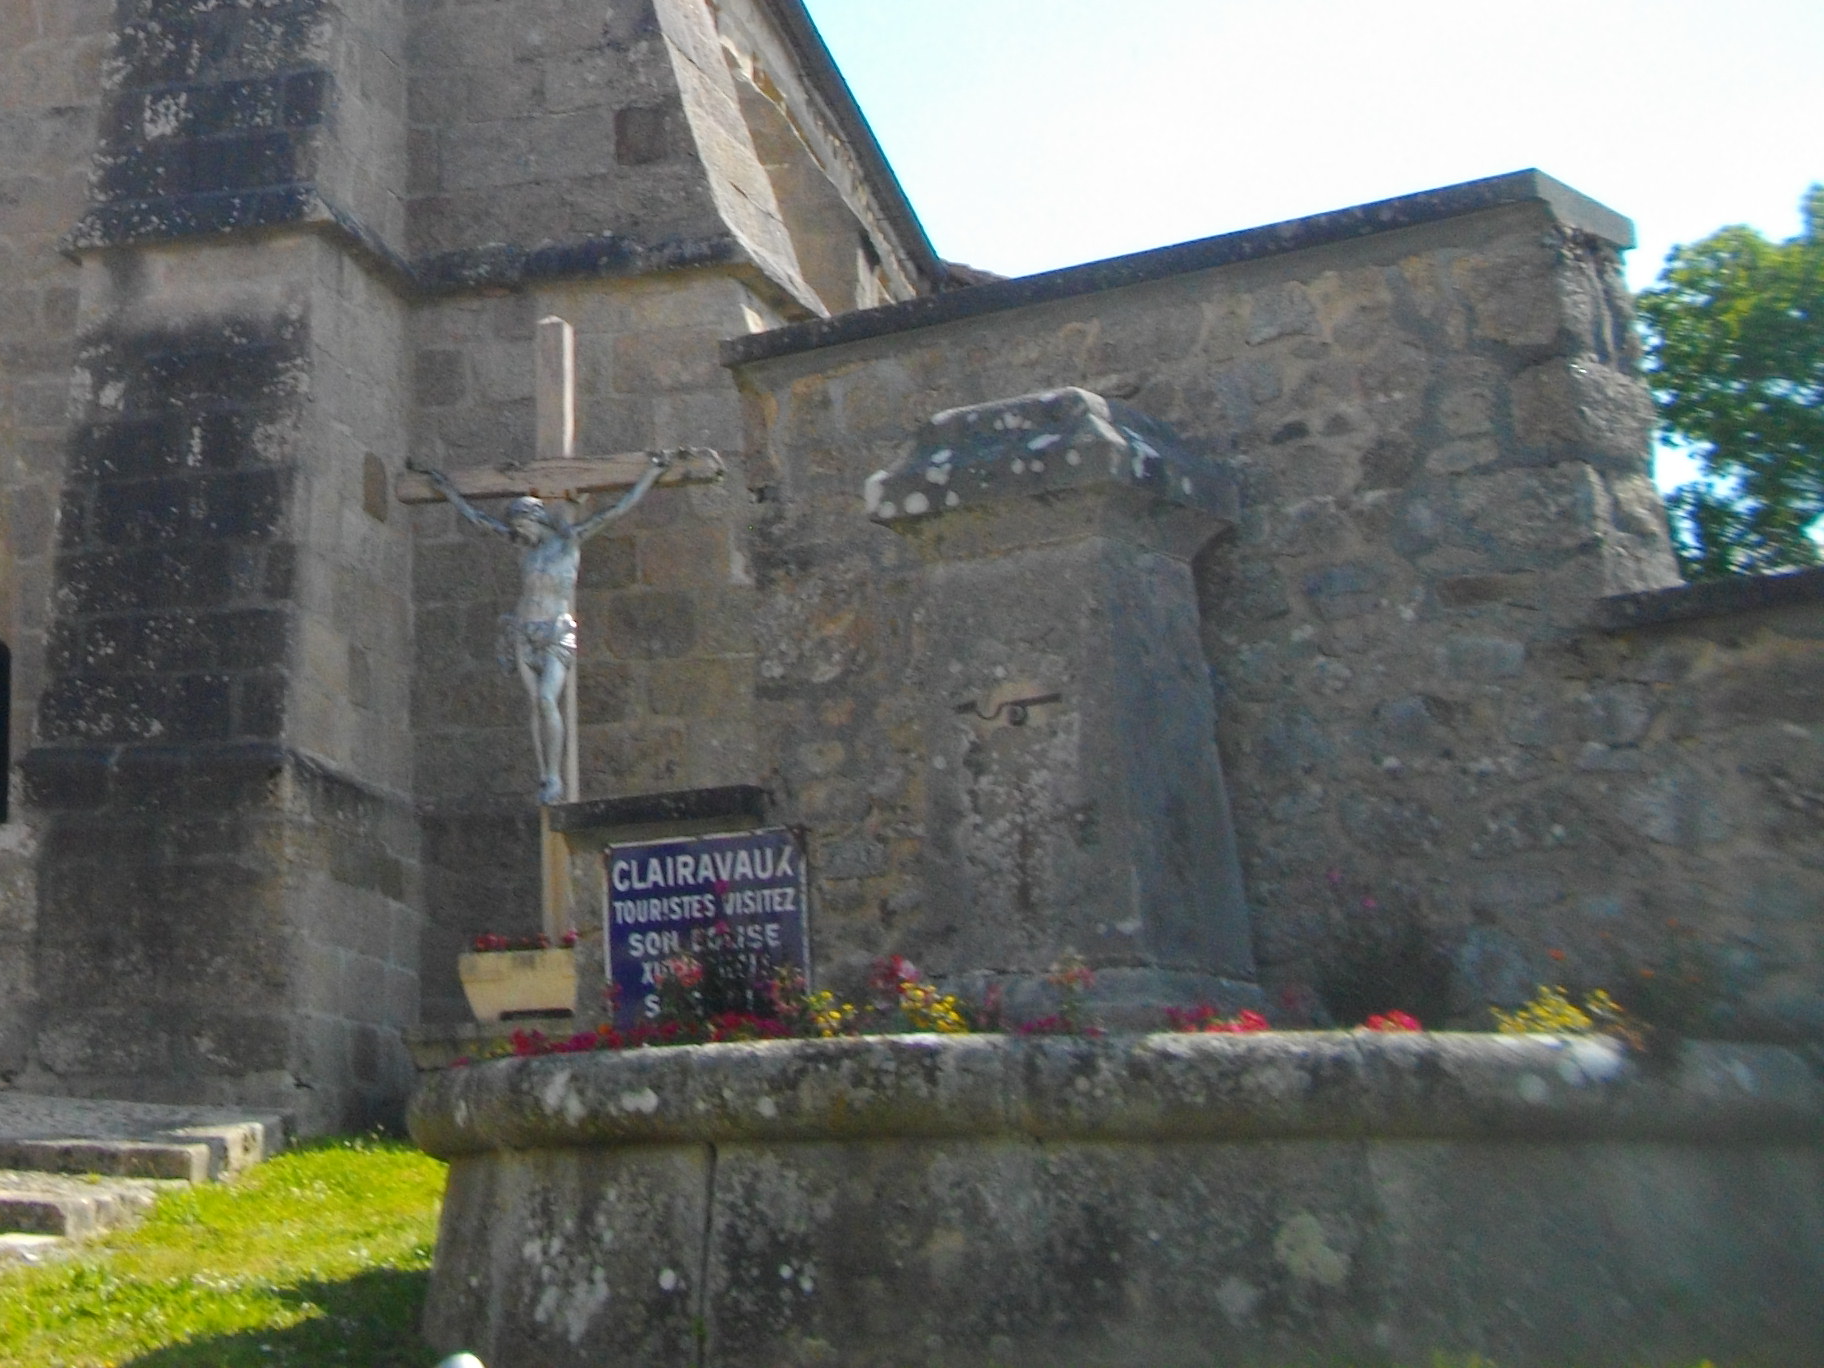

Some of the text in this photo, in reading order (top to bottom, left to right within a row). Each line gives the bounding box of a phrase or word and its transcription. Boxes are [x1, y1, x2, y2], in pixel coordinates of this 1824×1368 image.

[612, 845, 794, 892] CLAIRAVAUX
[613, 887, 797, 925] TOURISTES VISITEZ
[628, 930, 680, 958] SON
